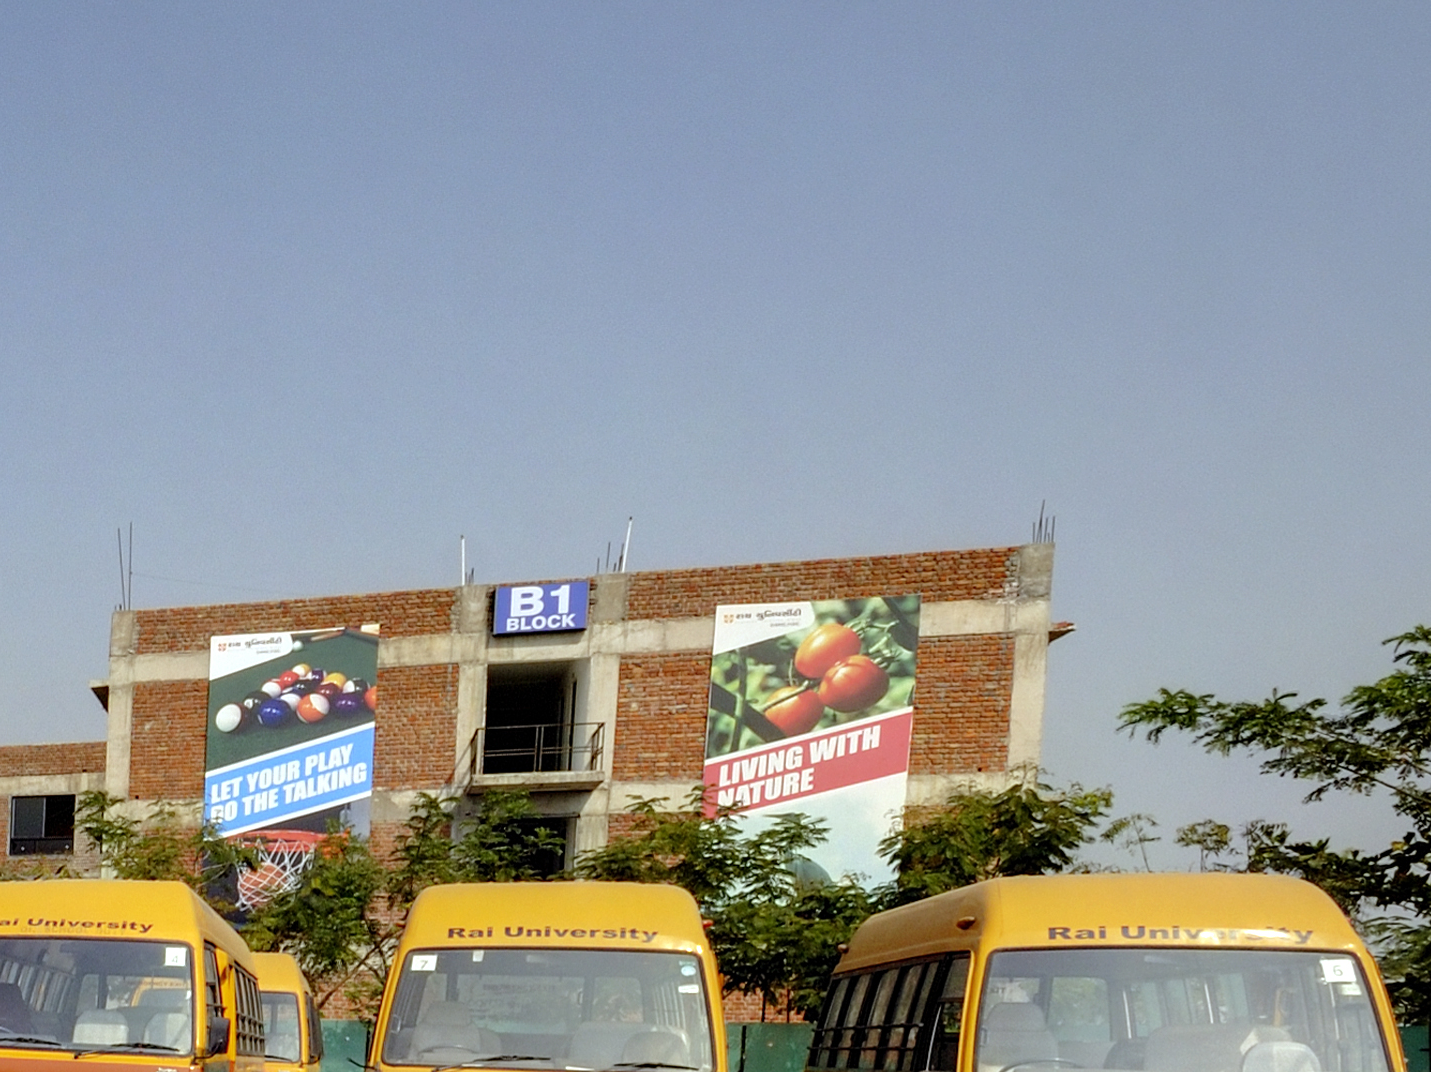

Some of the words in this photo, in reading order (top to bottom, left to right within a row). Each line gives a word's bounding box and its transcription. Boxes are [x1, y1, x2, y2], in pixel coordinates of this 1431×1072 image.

[510, 584, 570, 617] B1
[506, 614, 576, 632] BLOCK
[719, 746, 804, 788] LIVING
[809, 725, 881, 764] WITH
[211, 776, 243, 804] LET
[247, 760, 300, 793] YOUR
[304, 743, 354, 776] PLAY
[210, 800, 238, 824] DO
[242, 788, 279, 816] THE
[283, 762, 367, 805] TALKING
[717, 767, 815, 808] NATURE
[27, 918, 154, 934] University
[447, 927, 493, 939] Rai
[504, 927, 658, 943] University
[1048, 926, 1107, 940] Rai
[420, 960, 428, 969] 7
[1333, 965, 1343, 976] 6
